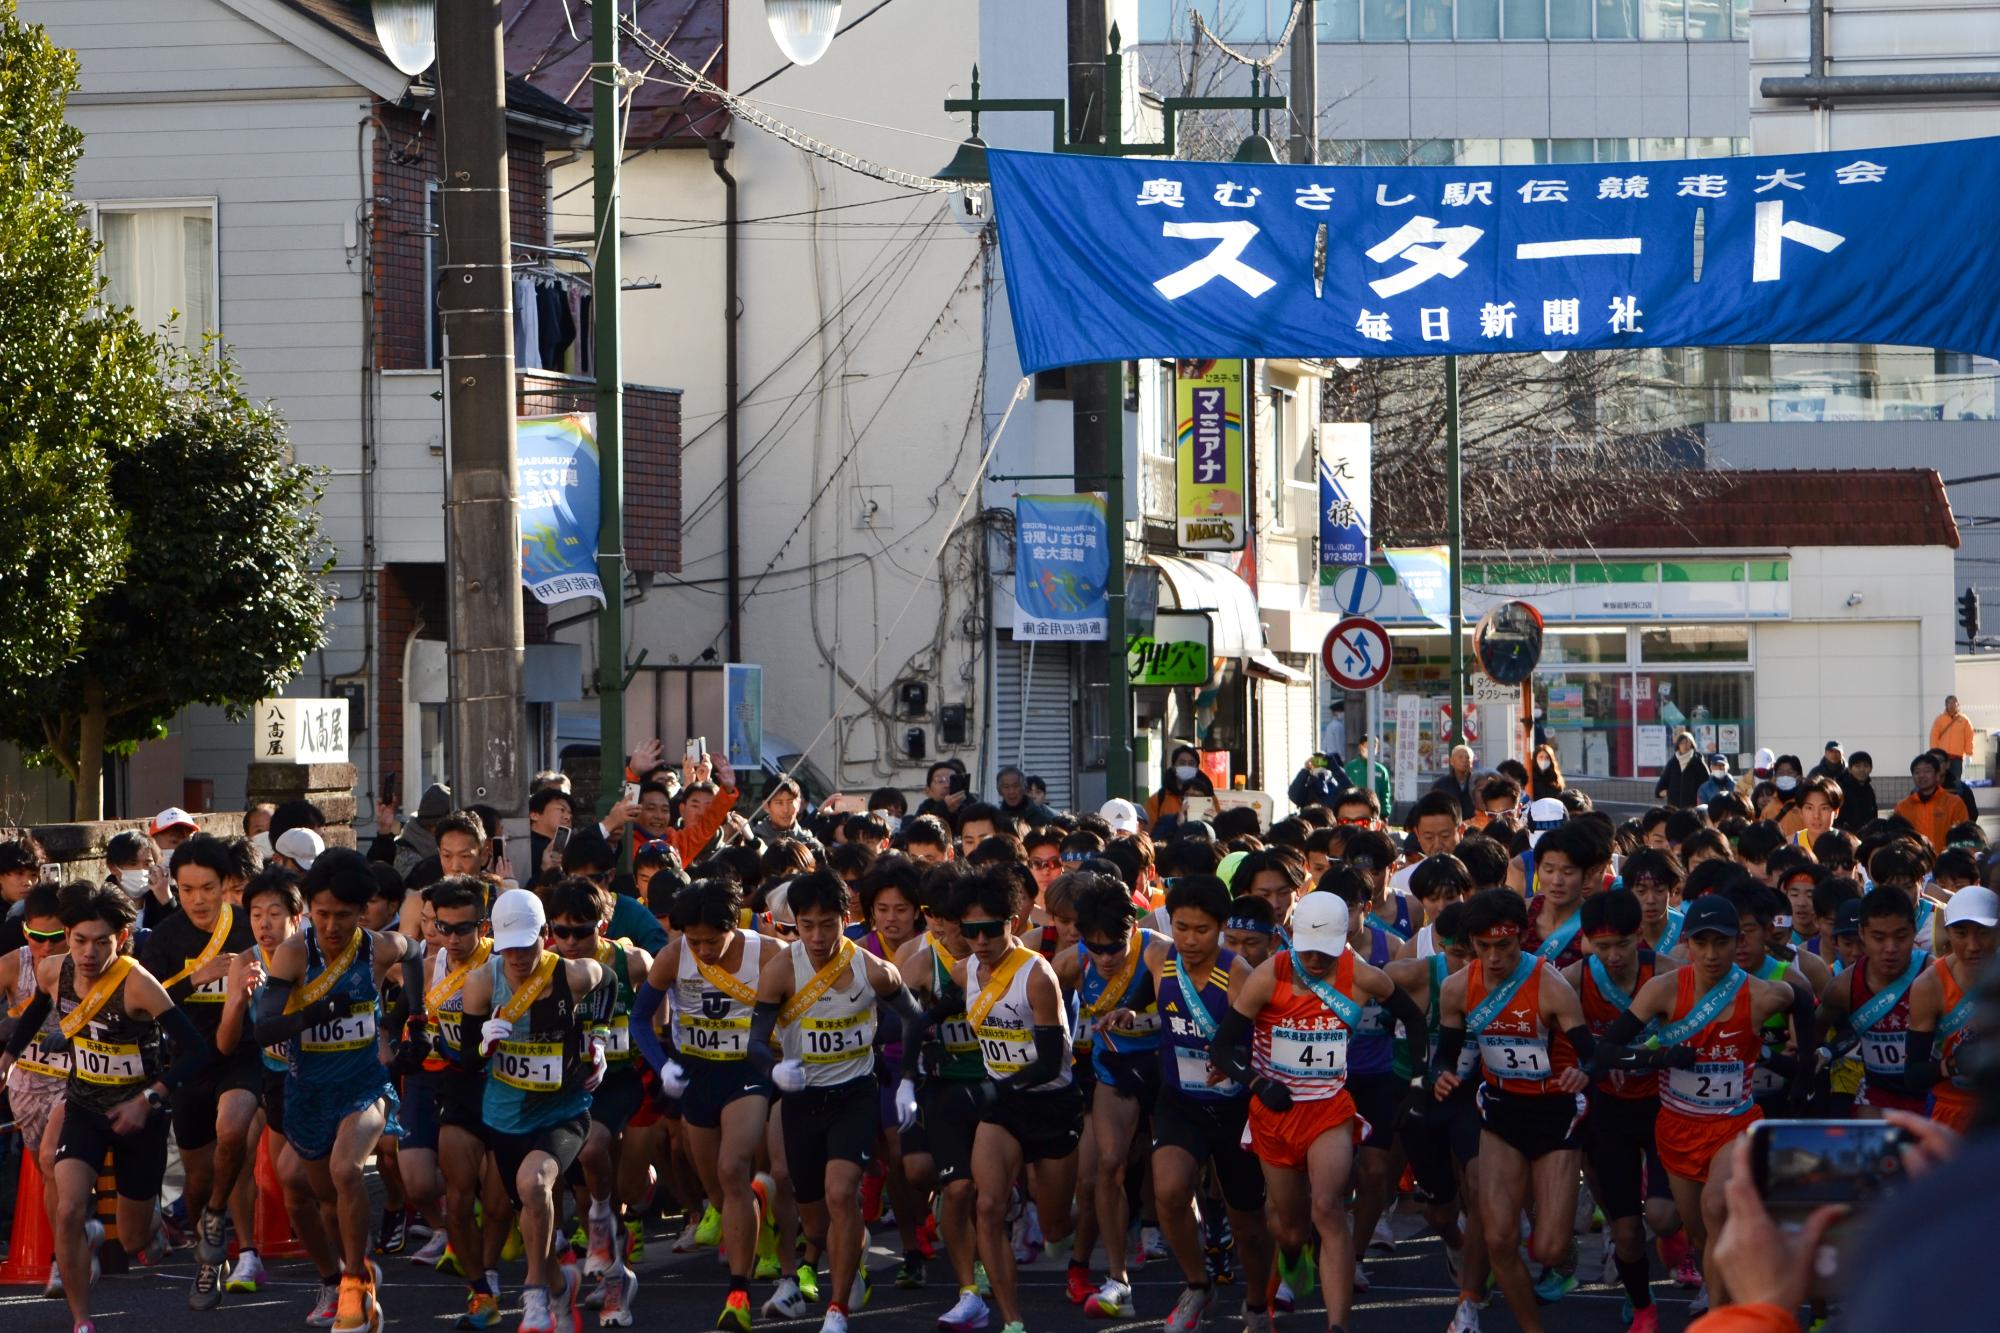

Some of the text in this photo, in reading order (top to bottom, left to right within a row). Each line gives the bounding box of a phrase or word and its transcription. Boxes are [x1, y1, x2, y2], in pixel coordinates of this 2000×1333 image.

[1137, 160, 1888, 208] 奥むさし駅伝競走大会
[1153, 200, 1846, 300] スタート
[1356, 295, 1644, 342] 毎日新聞社
[1326, 457, 1356, 530] 元禄
[1323, 552, 1363, 562] 972-5027
[266, 705, 286, 756] 八高屋
[300, 706, 344, 753] 八高屋
[686, 1027, 740, 1050] 104-1
[807, 1029, 863, 1053] 103-1
[980, 1039, 1030, 1062] 101-1
[80, 1049, 133, 1076] 107-1
[496, 1052, 551, 1081] 105-1
[1298, 1045, 1335, 1068] 4-1
[1503, 1048, 1539, 1071] 3-1
[1695, 1076, 1732, 1098] 2-1
